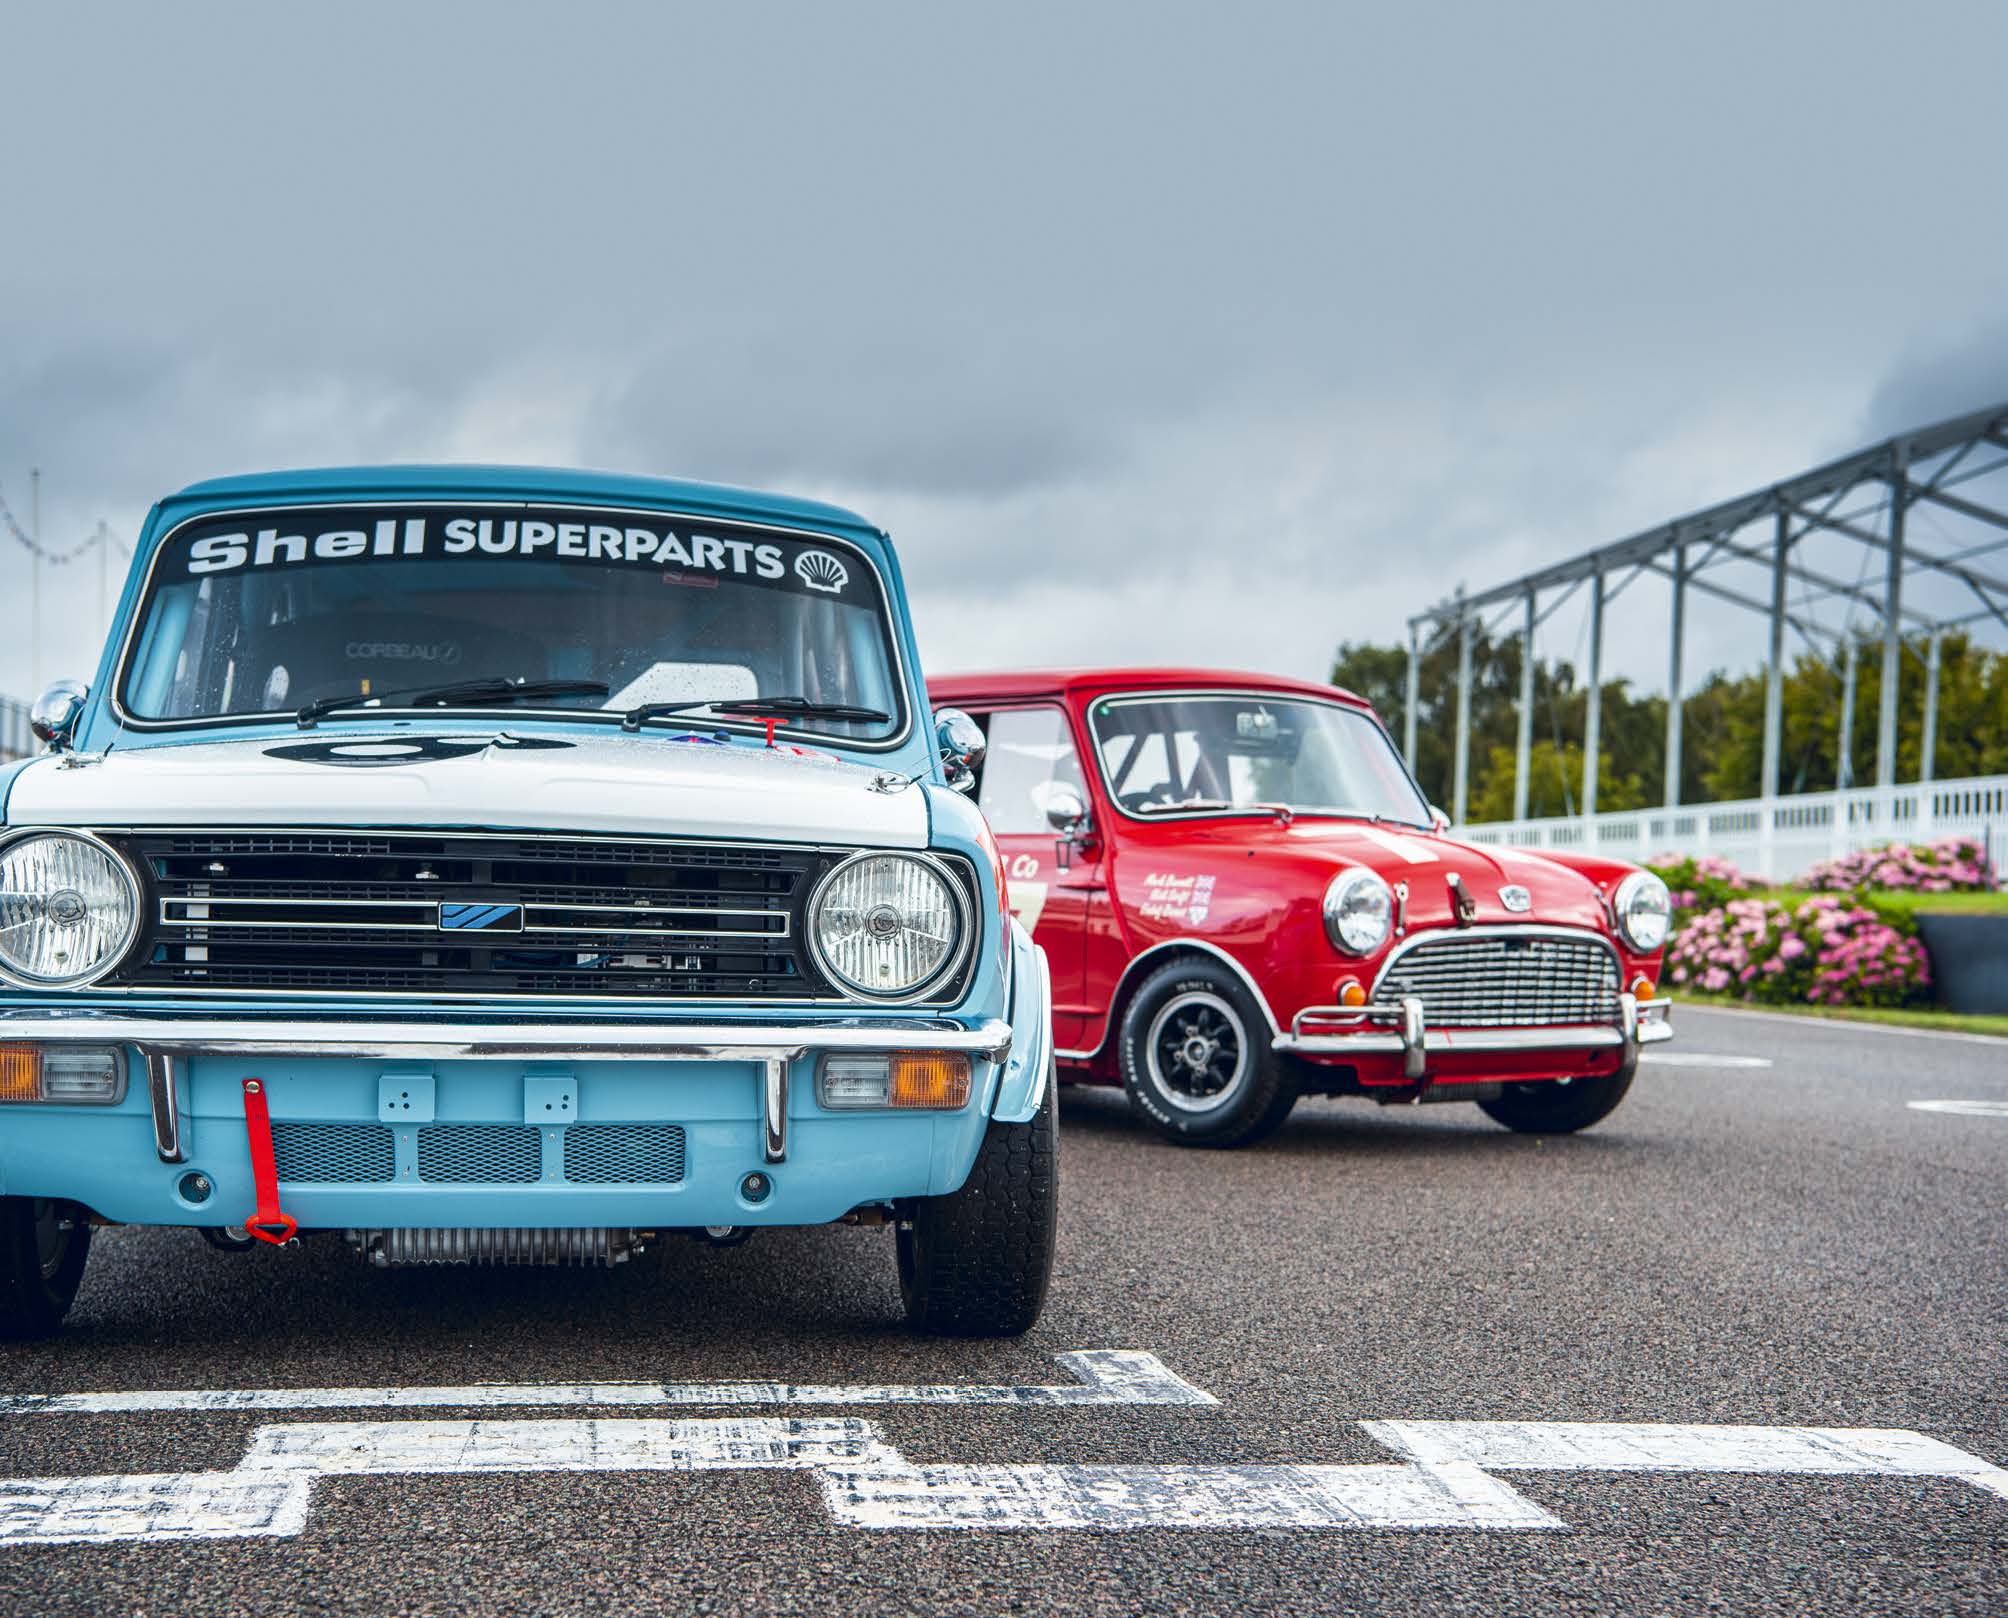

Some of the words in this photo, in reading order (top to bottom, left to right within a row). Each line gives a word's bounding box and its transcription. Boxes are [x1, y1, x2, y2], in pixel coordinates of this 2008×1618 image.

[188, 519, 426, 574] Shell
[444, 519, 785, 580] SUPERPARTS
[1011, 854, 1040, 879] Co
